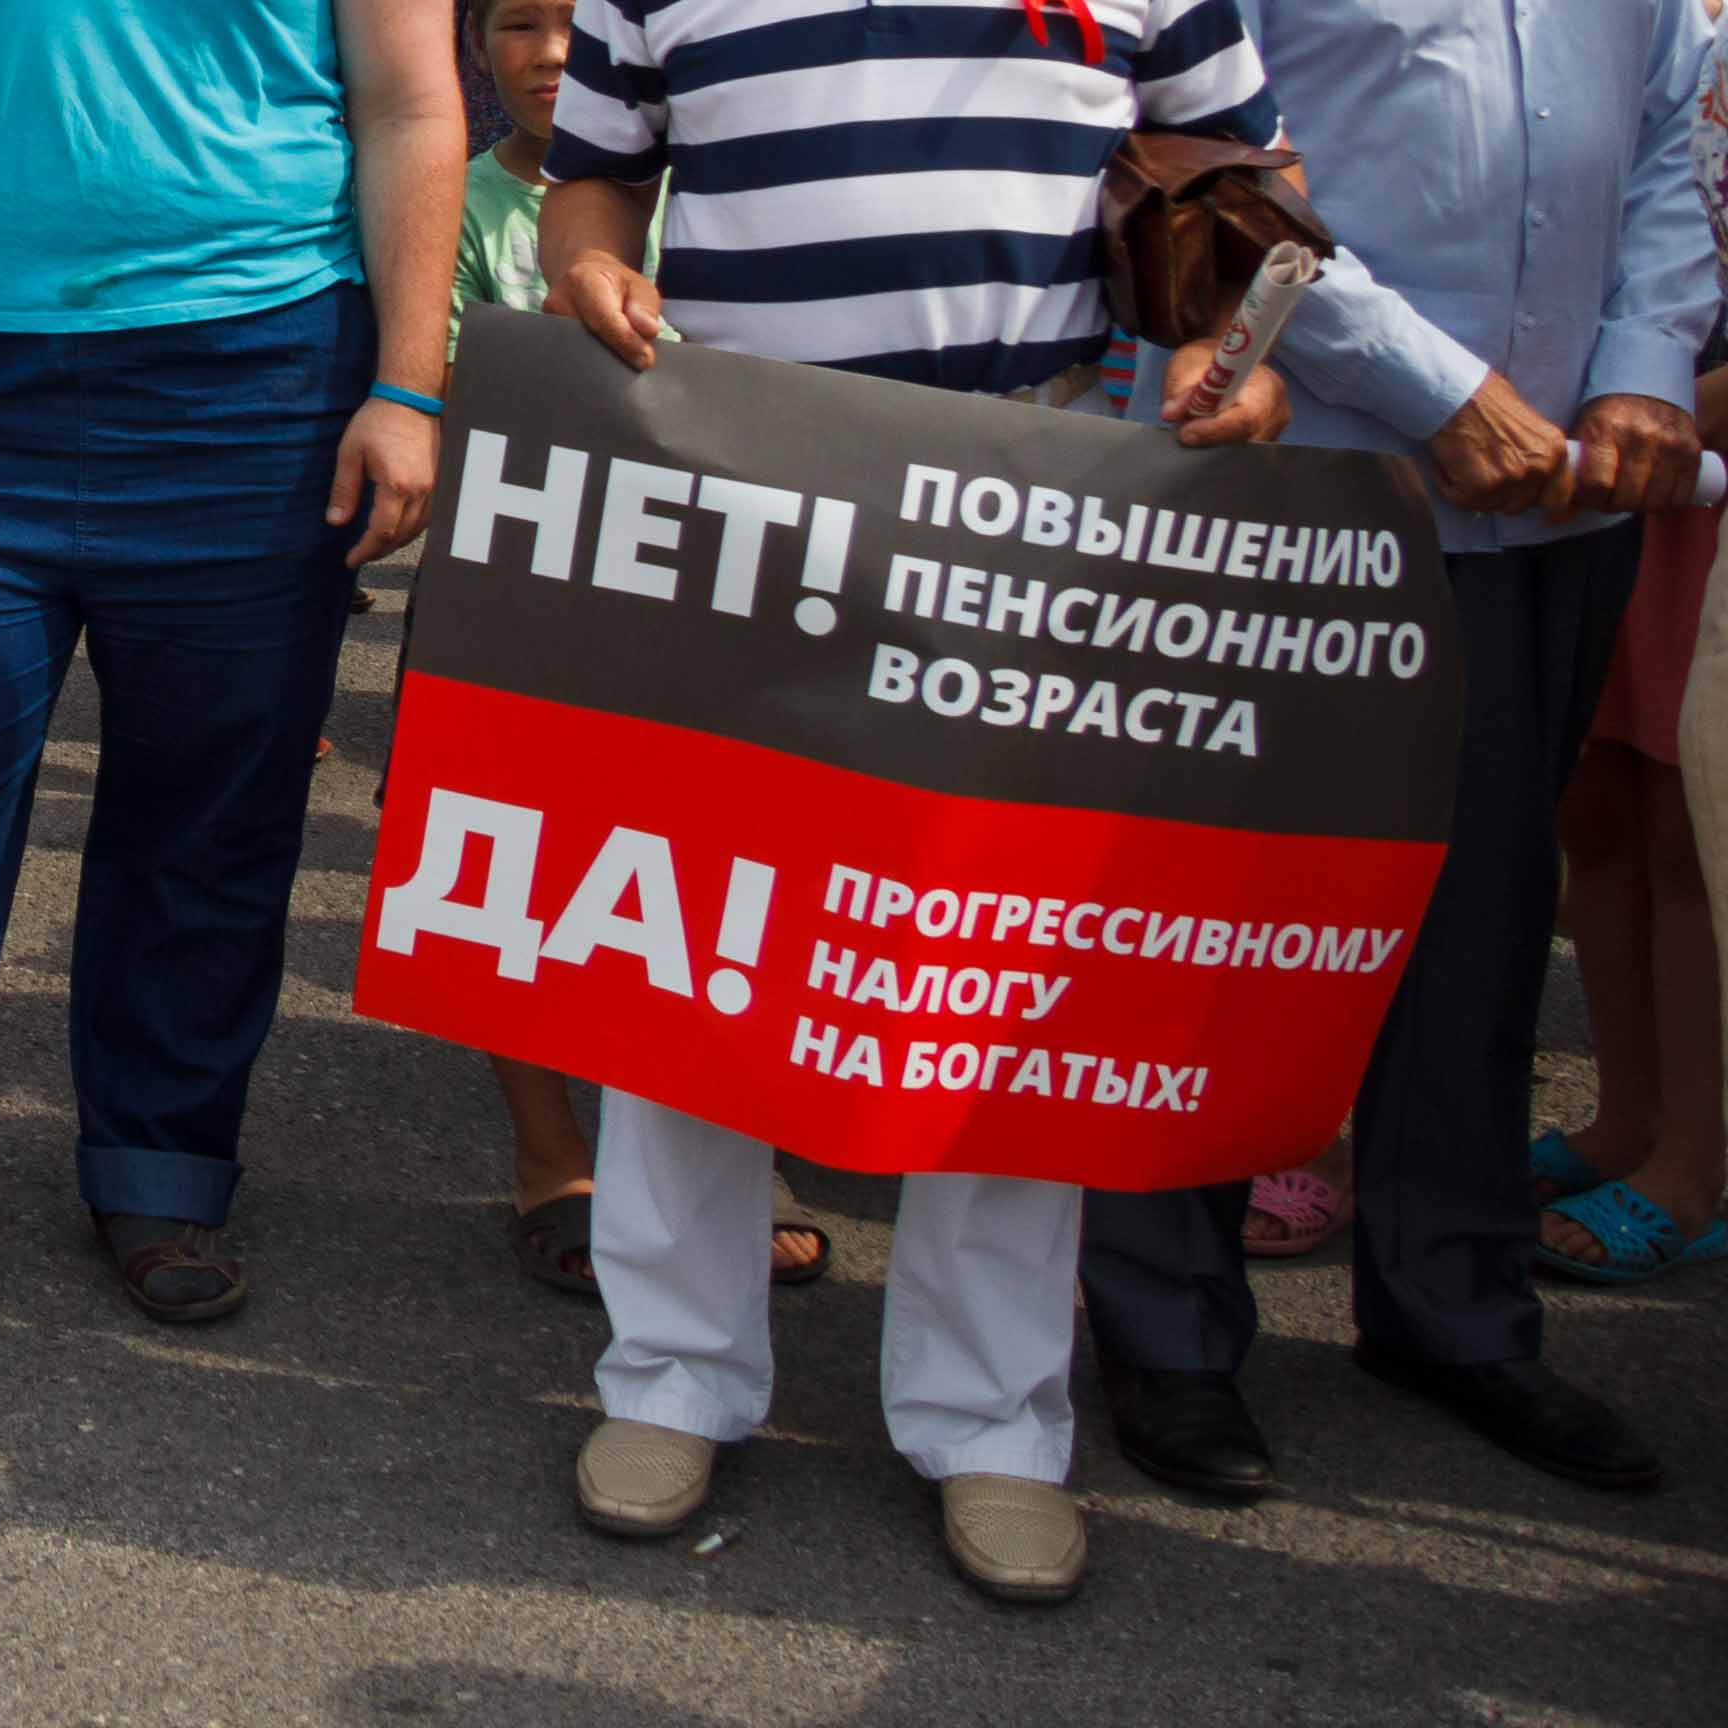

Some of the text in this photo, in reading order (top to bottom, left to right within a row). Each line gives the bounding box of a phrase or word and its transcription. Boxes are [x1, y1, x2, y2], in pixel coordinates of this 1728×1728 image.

[450, 429, 857, 636] НЕТ!
[899, 463, 1400, 588] ПОВЫШЕНИЮ
[884, 553, 1425, 679] ПЕНСИОННОГО
[868, 643, 1259, 757] ВОЗРАСТА
[376, 787, 776, 1015] ДА!
[824, 864, 1405, 975] ПРОГРЕССИВНОМУ
[808, 940, 1071, 1020] НАЛОГУ
[790, 1016, 1208, 1114] НА БОГАТЫХ!
